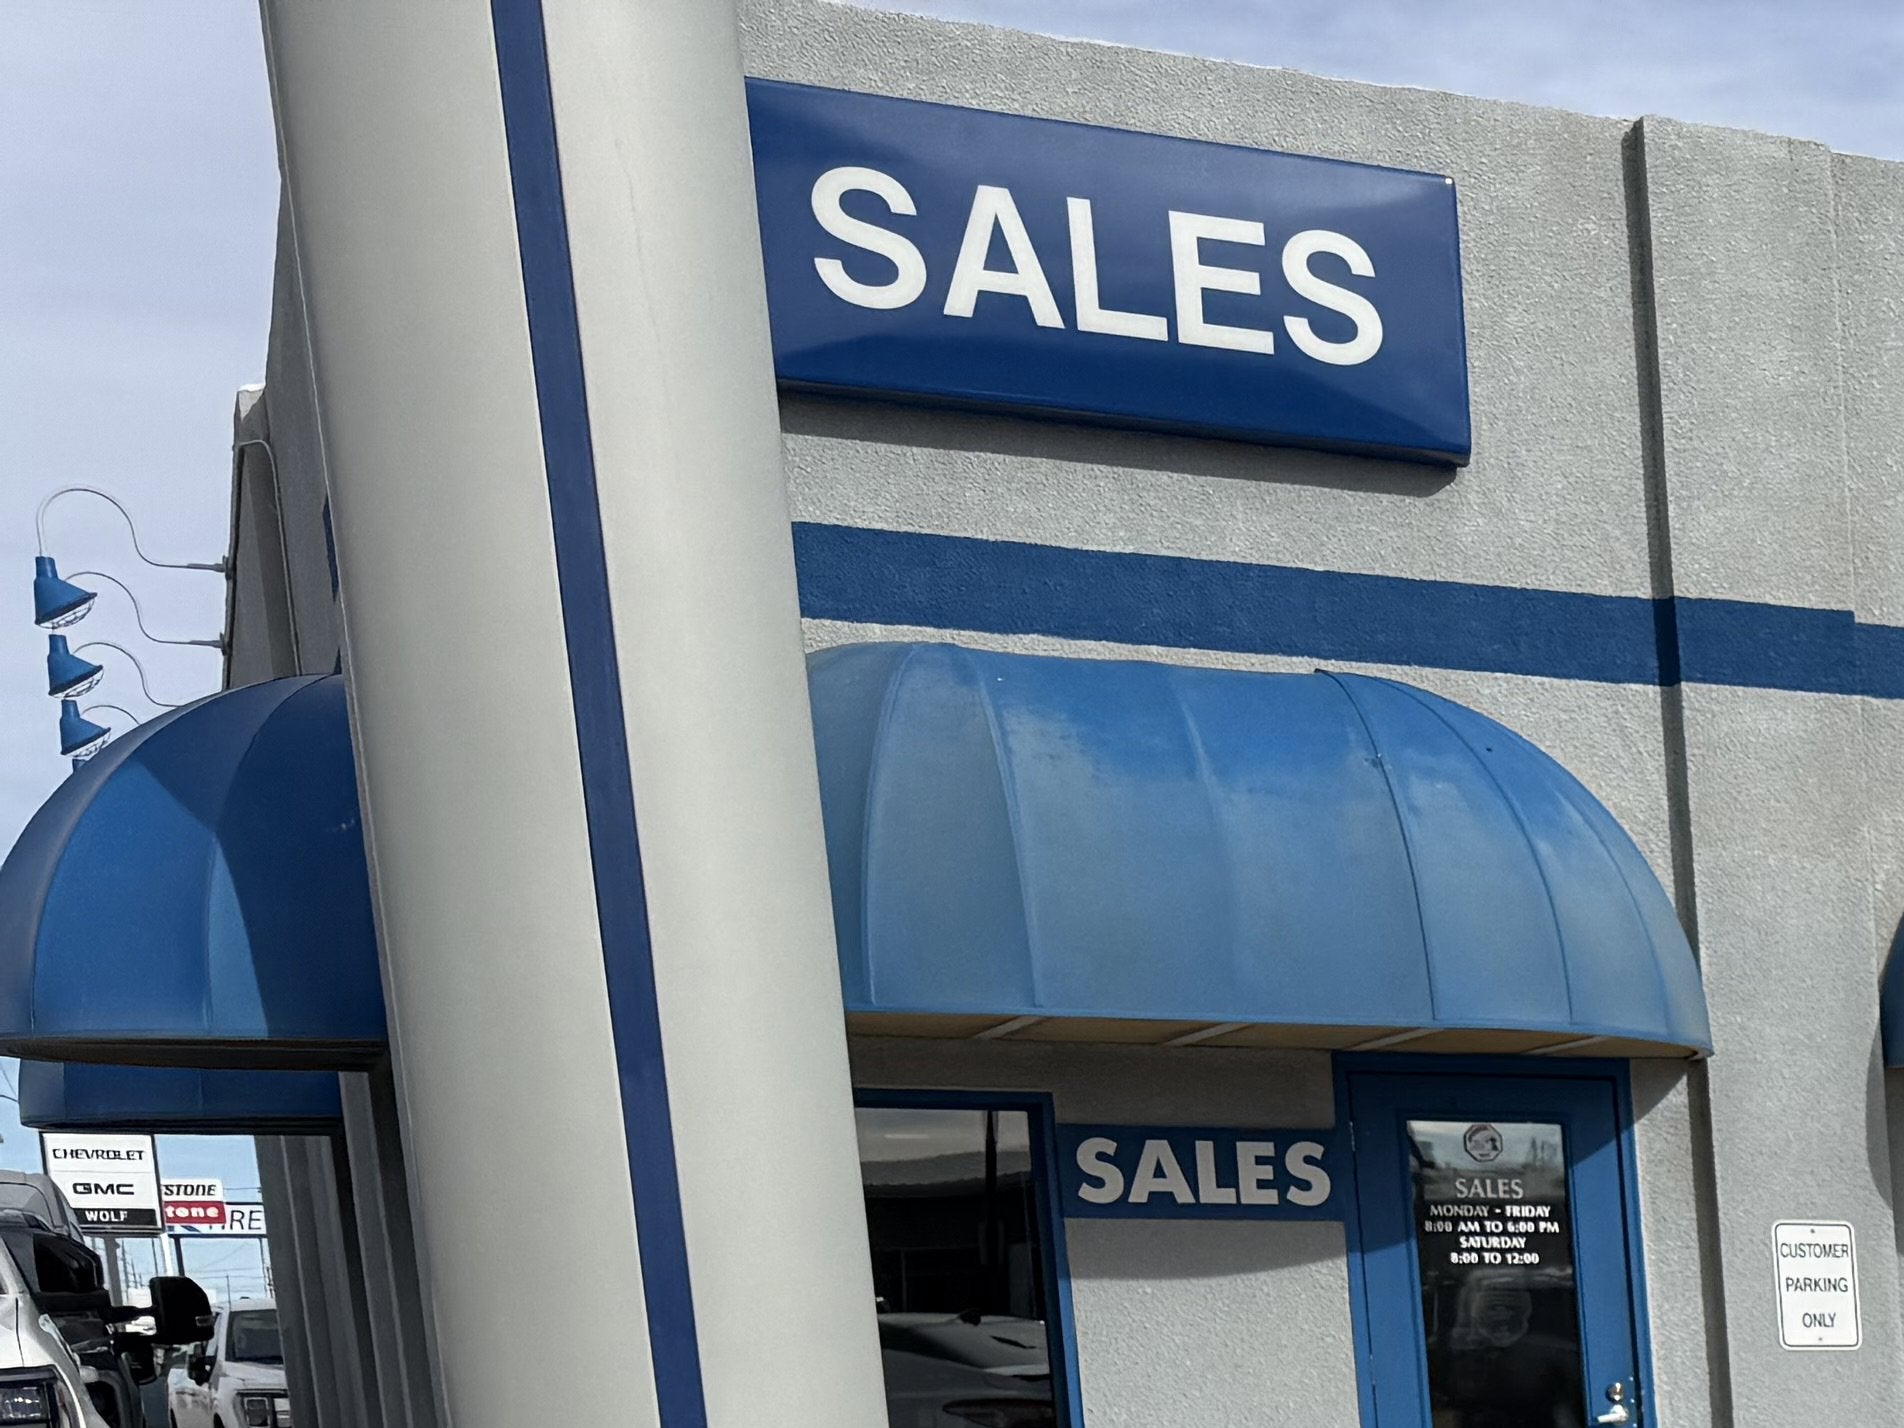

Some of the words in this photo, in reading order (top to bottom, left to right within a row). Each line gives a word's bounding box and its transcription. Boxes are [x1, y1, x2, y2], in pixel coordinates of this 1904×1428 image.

[811, 166, 1383, 366] SALES
[52, 1148, 144, 1161] CHEVROLET
[1076, 1137, 1331, 1206] SALES
[72, 1182, 134, 1195] GMC
[162, 1184, 216, 1196] STONE
[1455, 1178, 1524, 1199] SALES
[85, 1210, 127, 1222] WOLF
[165, 1205, 219, 1217] tone
[1430, 1204, 1490, 1217] MONDAY
[1505, 1205, 1551, 1217] FRIDAY
[1424, 1221, 1453, 1232] 8:00
[1457, 1221, 1481, 1232] AM
[1485, 1221, 1503, 1233] TO
[1507, 1221, 1535, 1232] 6:00
[1539, 1222, 1560, 1233] PM
[1459, 1236, 1526, 1249] SATURDAY
[1780, 1242, 1849, 1258] CUSTOMER
[1450, 1252, 1479, 1264] 8:00
[1483, 1252, 1502, 1264] TO
[1506, 1253, 1540, 1264] 12:00
[1786, 1277, 1849, 1293] PARKING
[1802, 1312, 1837, 1328] ONLY
